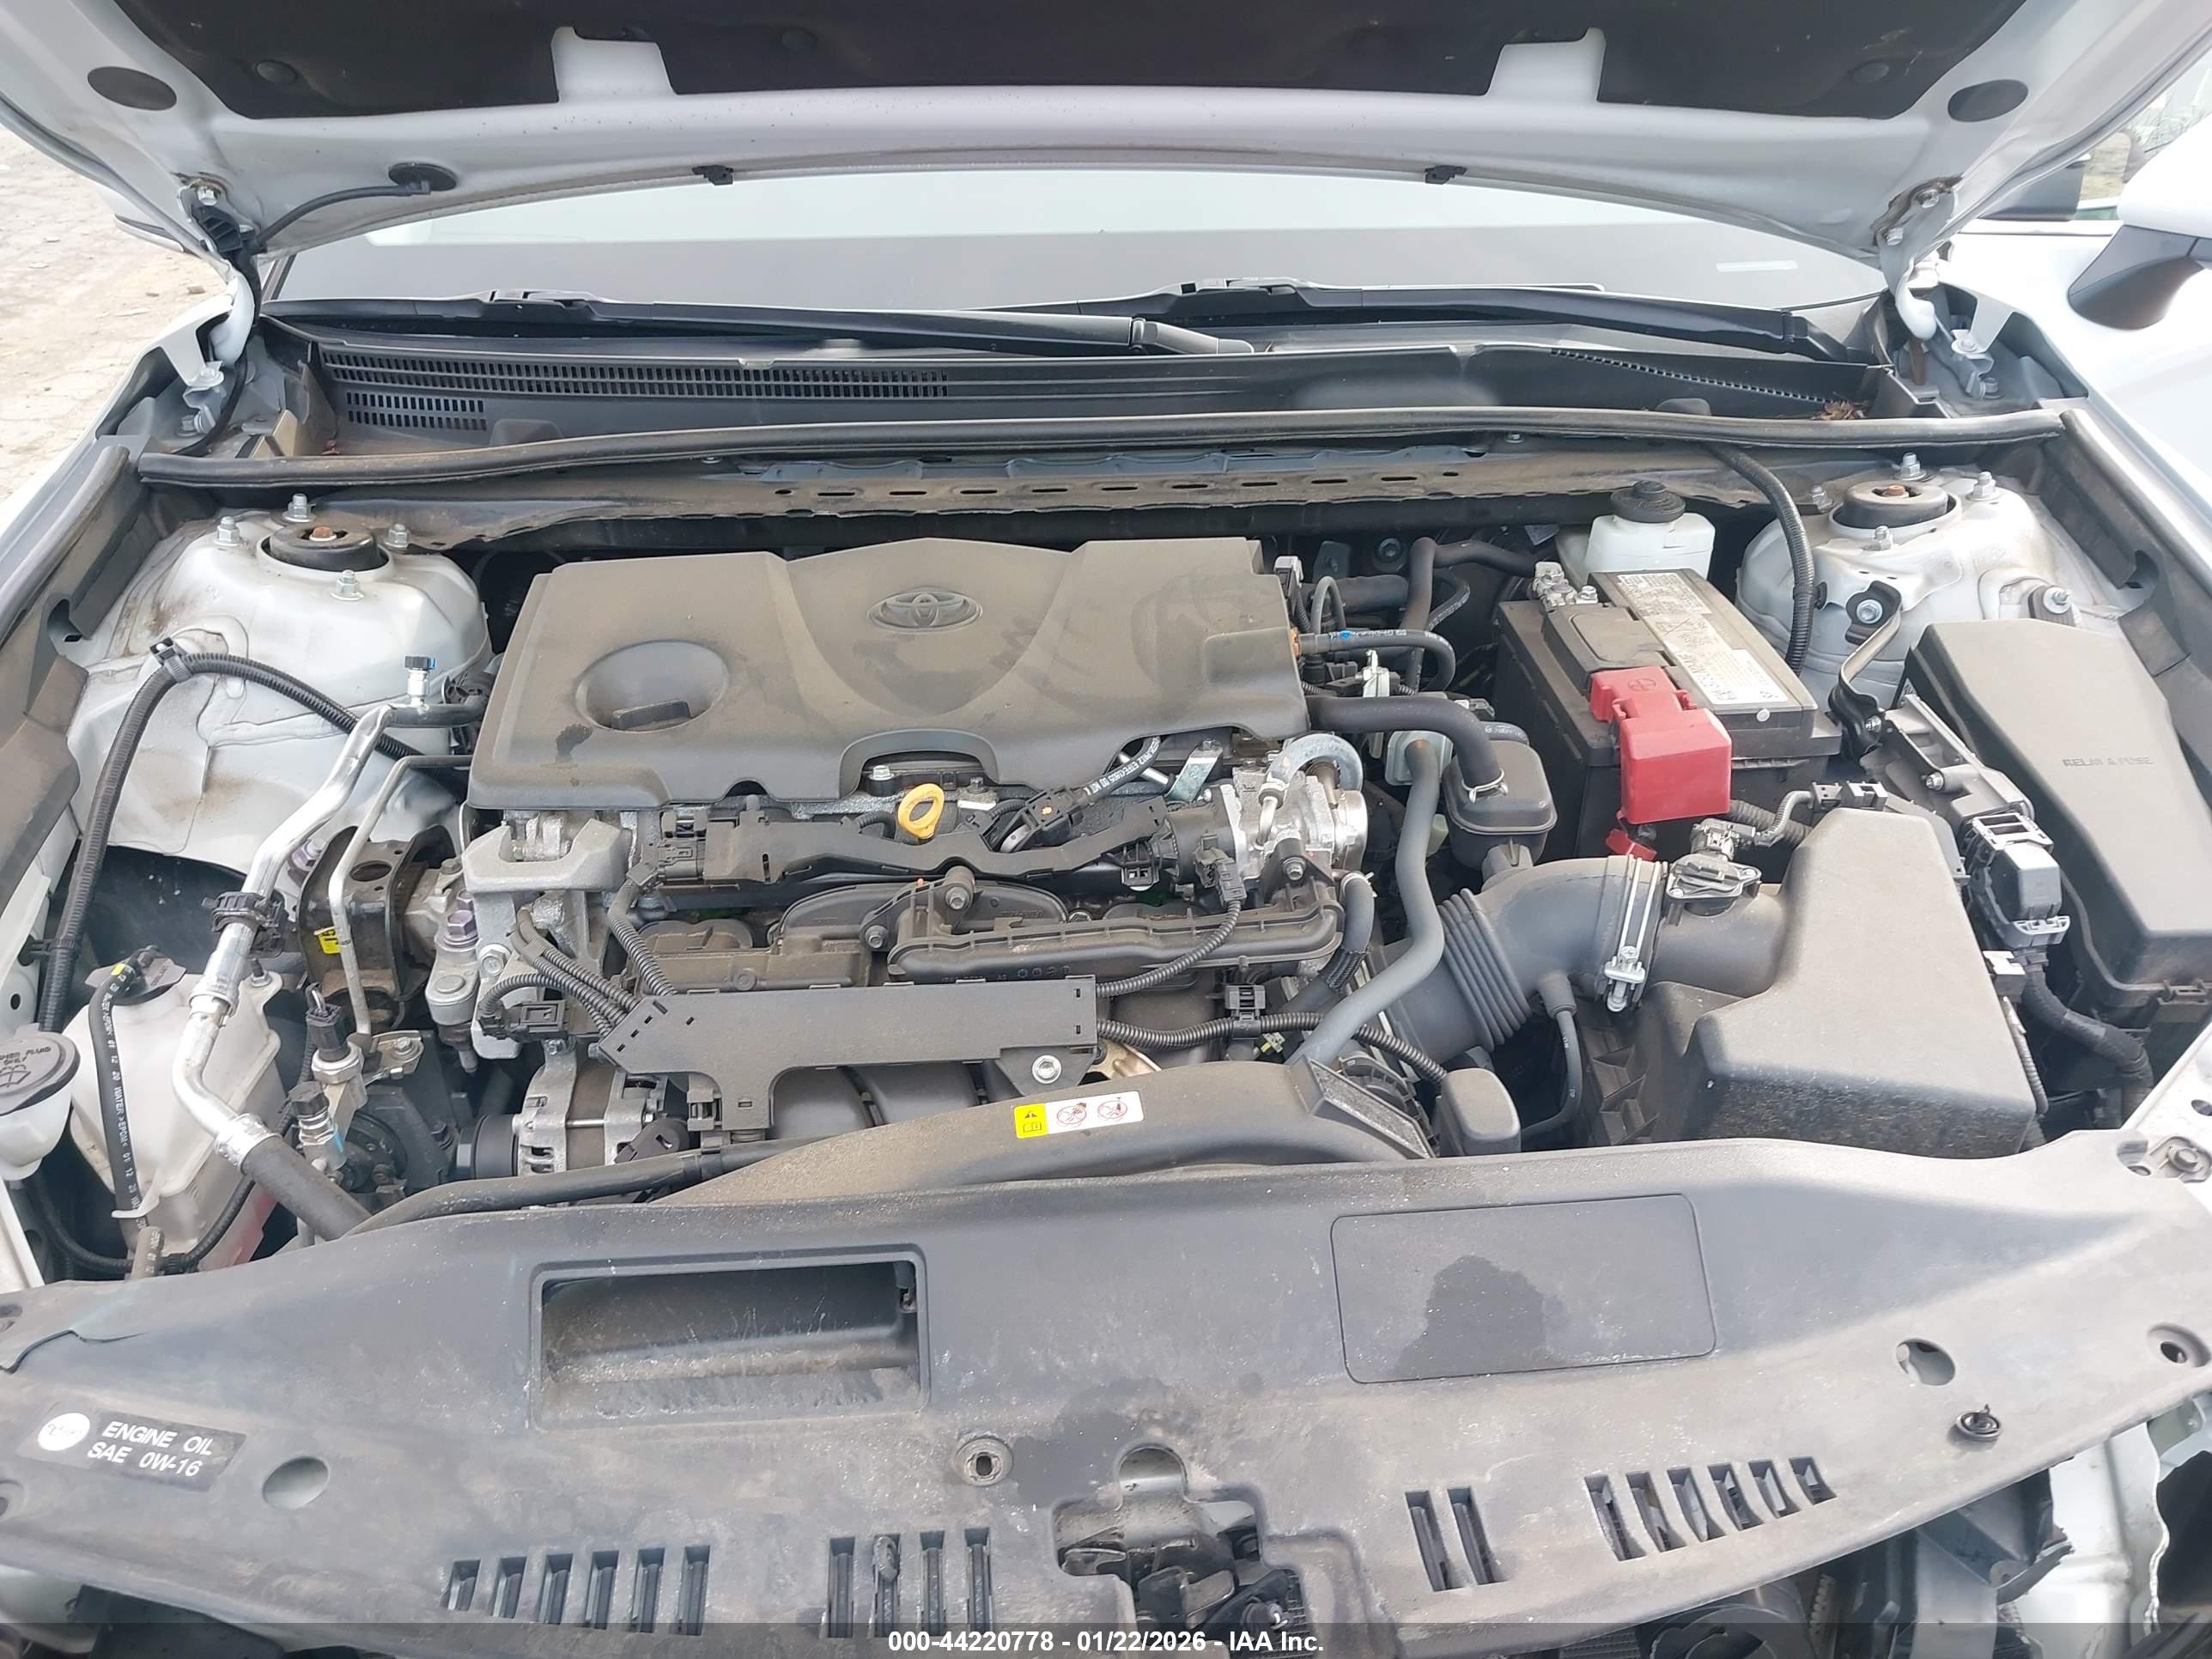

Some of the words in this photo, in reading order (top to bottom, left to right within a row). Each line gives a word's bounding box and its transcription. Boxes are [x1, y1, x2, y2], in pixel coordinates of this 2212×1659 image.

[112, 1071, 121, 1081] 20
[114, 1086, 125, 1115] WATER
[102, 1420, 178, 1448] ENGINE
[183, 1436, 213, 1455] OIL
[87, 1441, 133, 1463] SAE
[138, 1451, 203, 1477] 0W-16
